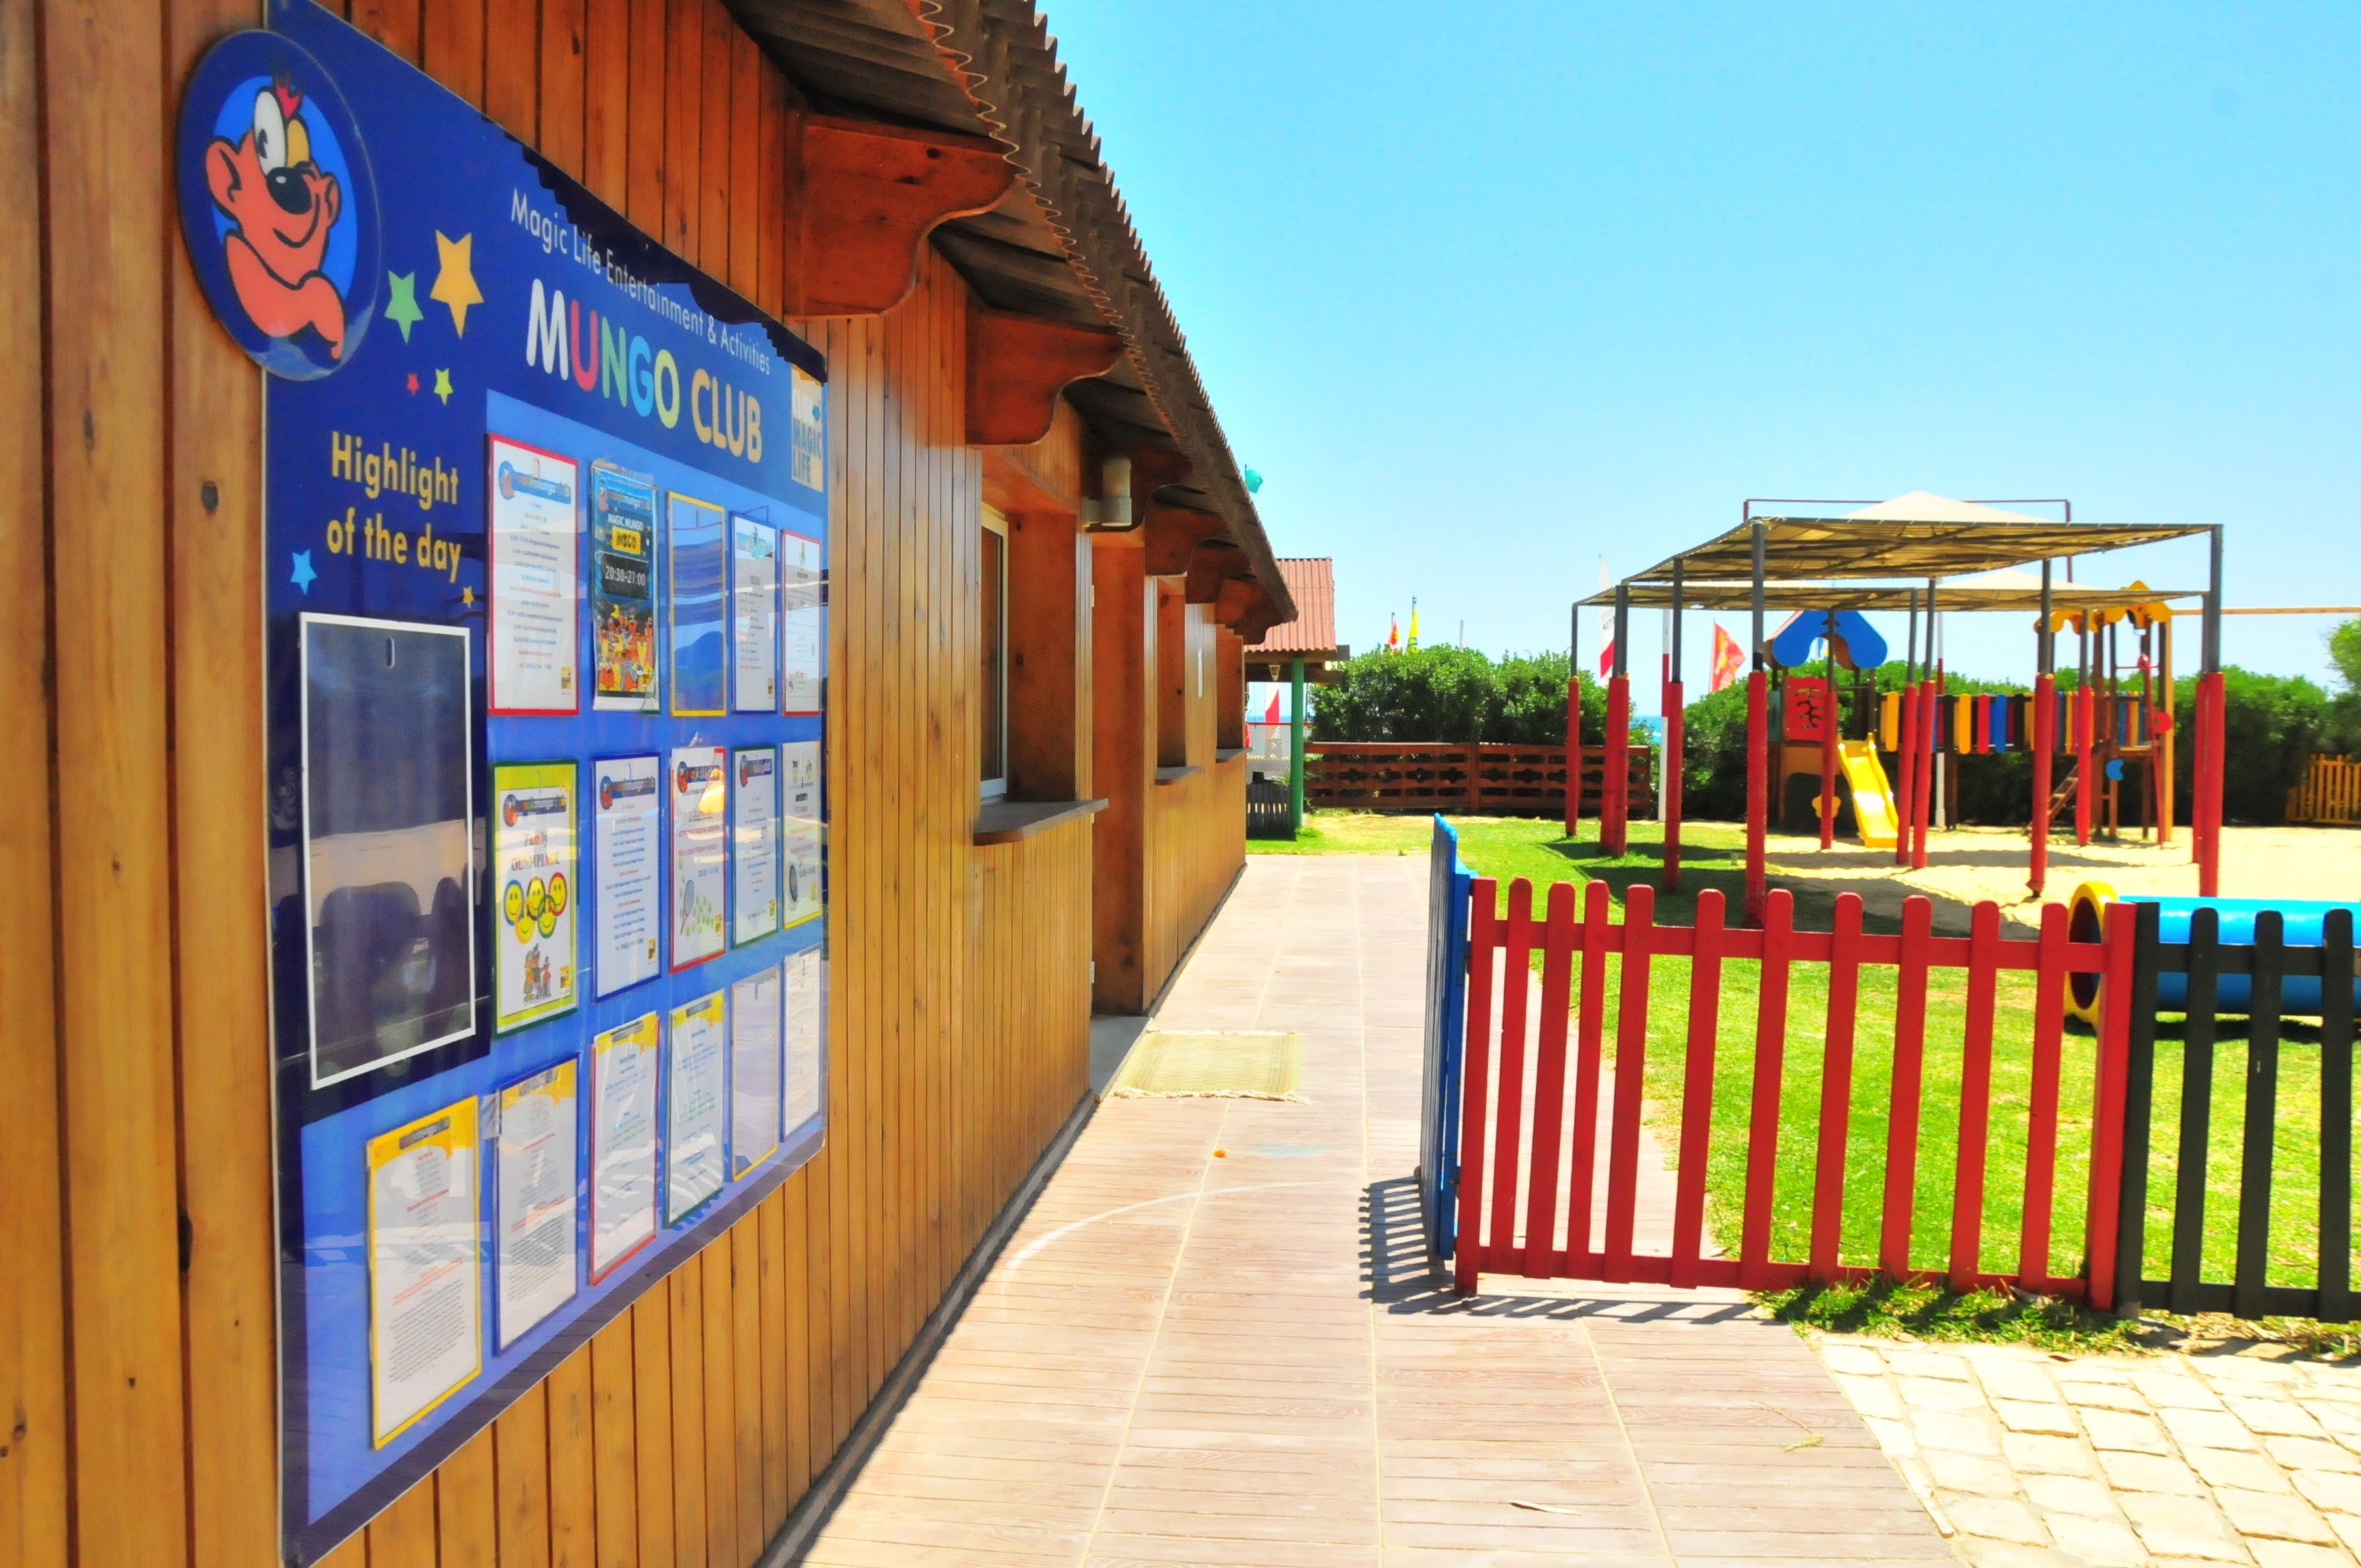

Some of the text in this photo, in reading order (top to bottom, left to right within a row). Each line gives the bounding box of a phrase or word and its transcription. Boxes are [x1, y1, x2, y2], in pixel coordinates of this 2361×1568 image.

[511, 187, 770, 376] Magic Life Entertainment & Activities
[526, 278, 762, 463] MUNGO CLUB
[332, 430, 459, 510] Highlight
[327, 507, 355, 555] of
[364, 512, 407, 564] the
[417, 523, 461, 583] day
[607, 513, 644, 531] MAGIC MUNGO
[616, 530, 637, 550] DISCO
